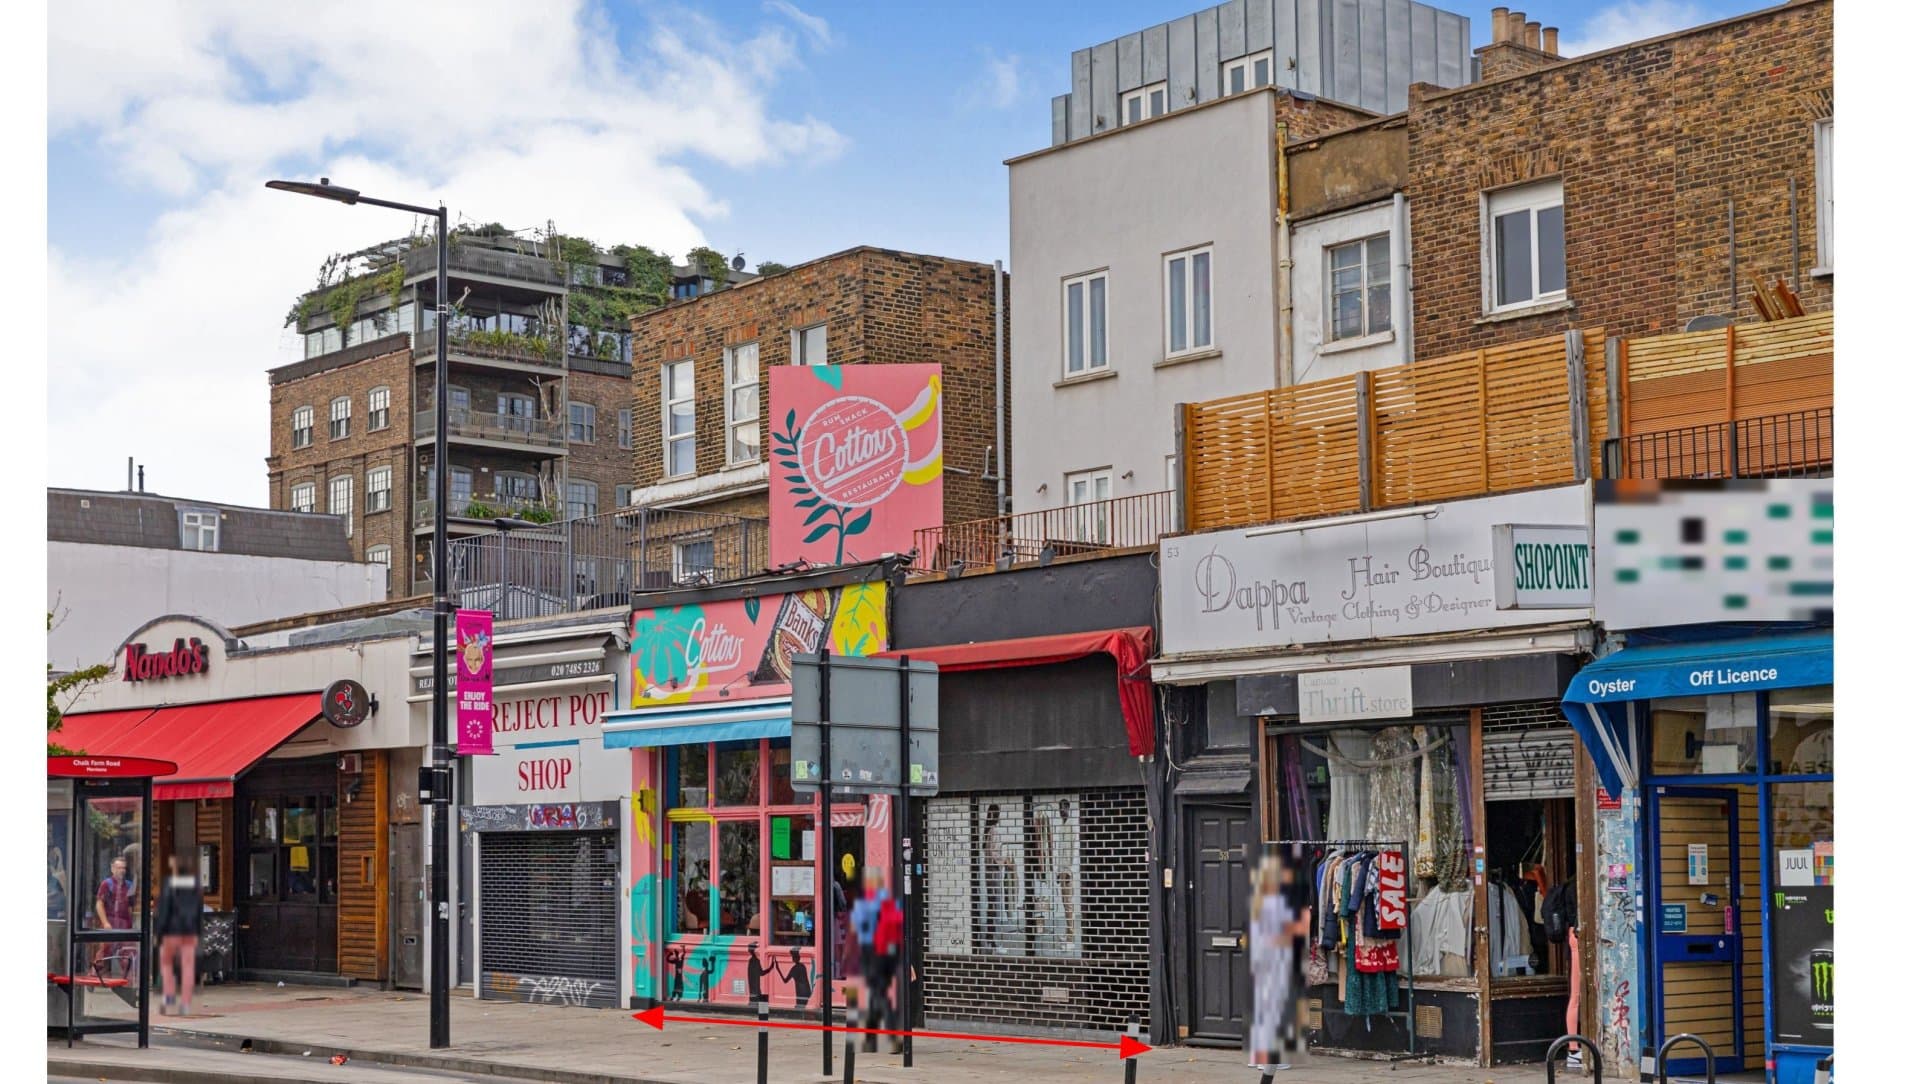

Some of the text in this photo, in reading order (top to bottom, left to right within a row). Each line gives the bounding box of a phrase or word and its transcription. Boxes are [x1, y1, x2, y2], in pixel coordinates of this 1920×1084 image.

[822, 414, 842, 427] RUM
[813, 425, 897, 488] Cottons
[841, 469, 896, 499] RESTAURANT
[1167, 547, 1180, 558] 53
[1514, 543, 1589, 590] SHOPOINT
[1195, 543, 1310, 631] Dappa
[1341, 555, 1400, 600] Hair
[785, 603, 819, 652] Banks
[1286, 607, 1338, 629] Vintage
[1342, 601, 1400, 623] Clothing
[1422, 592, 1492, 616] Designer
[122, 637, 206, 681] Nando's
[685, 617, 743, 673] Cottons
[551, 661, 600, 677] 020 7485 2326
[1588, 668, 1778, 698] Oyster Off Licence
[460, 701, 490, 711] THE RIDE
[463, 691, 485, 701] ENJOY
[492, 697, 562, 732] REJECT
[570, 692, 609, 725] POT
[73, 759, 90, 767] Chalk
[518, 758, 572, 792] SHOP
[1785, 857, 1809, 870] JUUL
[1381, 853, 1407, 927] SALE
